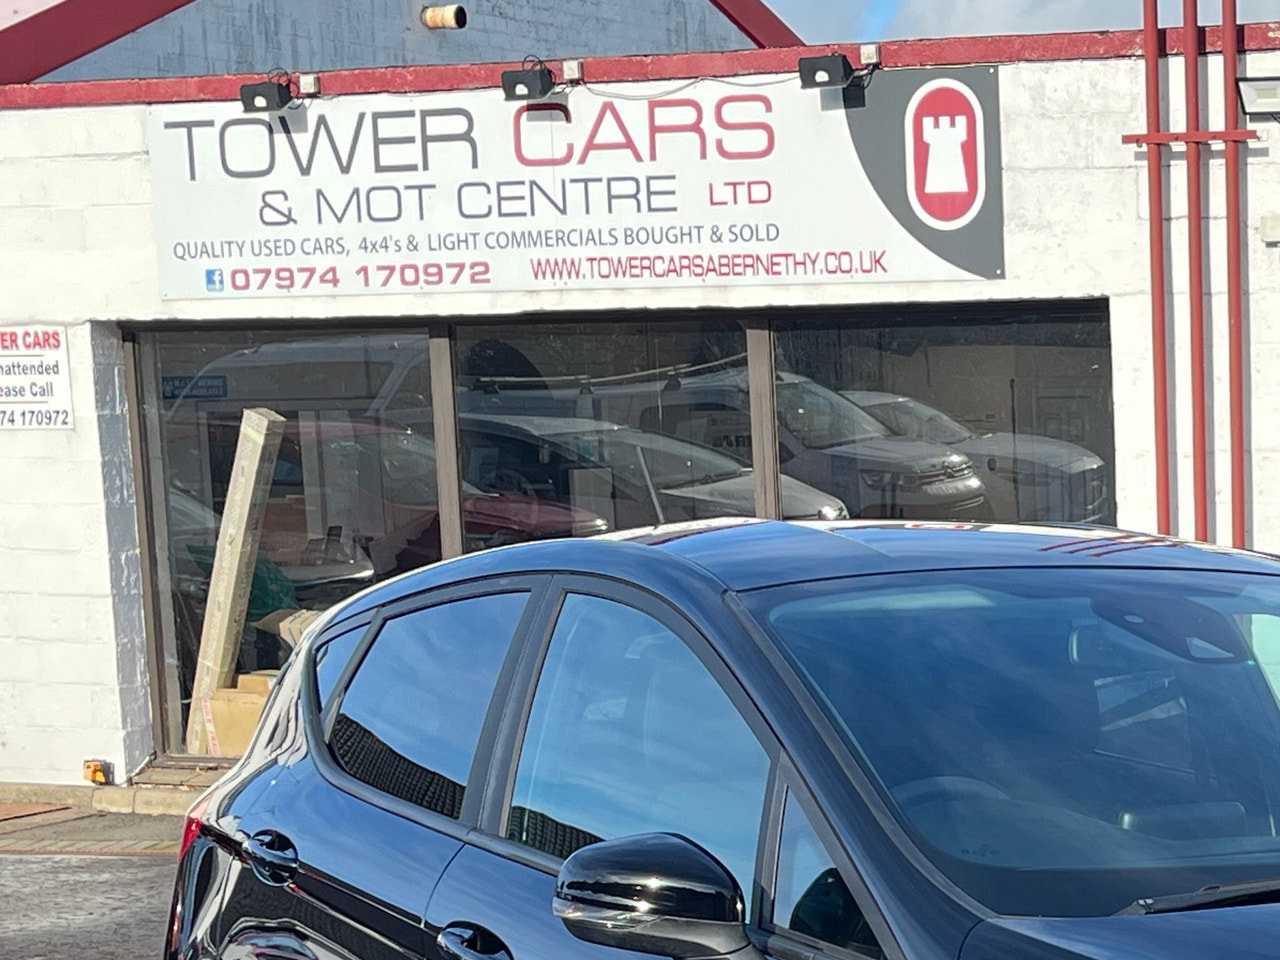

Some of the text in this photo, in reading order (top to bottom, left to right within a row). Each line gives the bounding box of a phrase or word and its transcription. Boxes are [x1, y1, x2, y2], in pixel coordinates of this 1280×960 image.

[164, 94, 775, 181] TOWER CARS
[259, 174, 771, 226] & MOT CENTRE LTD
[173, 223, 780, 261] QUALITY USED CARS, 4x4's & LIGHT COMMERCIALS BOUGHT & SOLD
[230, 261, 491, 291] 07974 170972
[530, 250, 888, 280] WWW.TOWERCARSABERNETHY.CO.UK
[22, 331, 61, 350] CARS
[29, 382, 54, 397] Call
[20, 410, 69, 426] 170972
